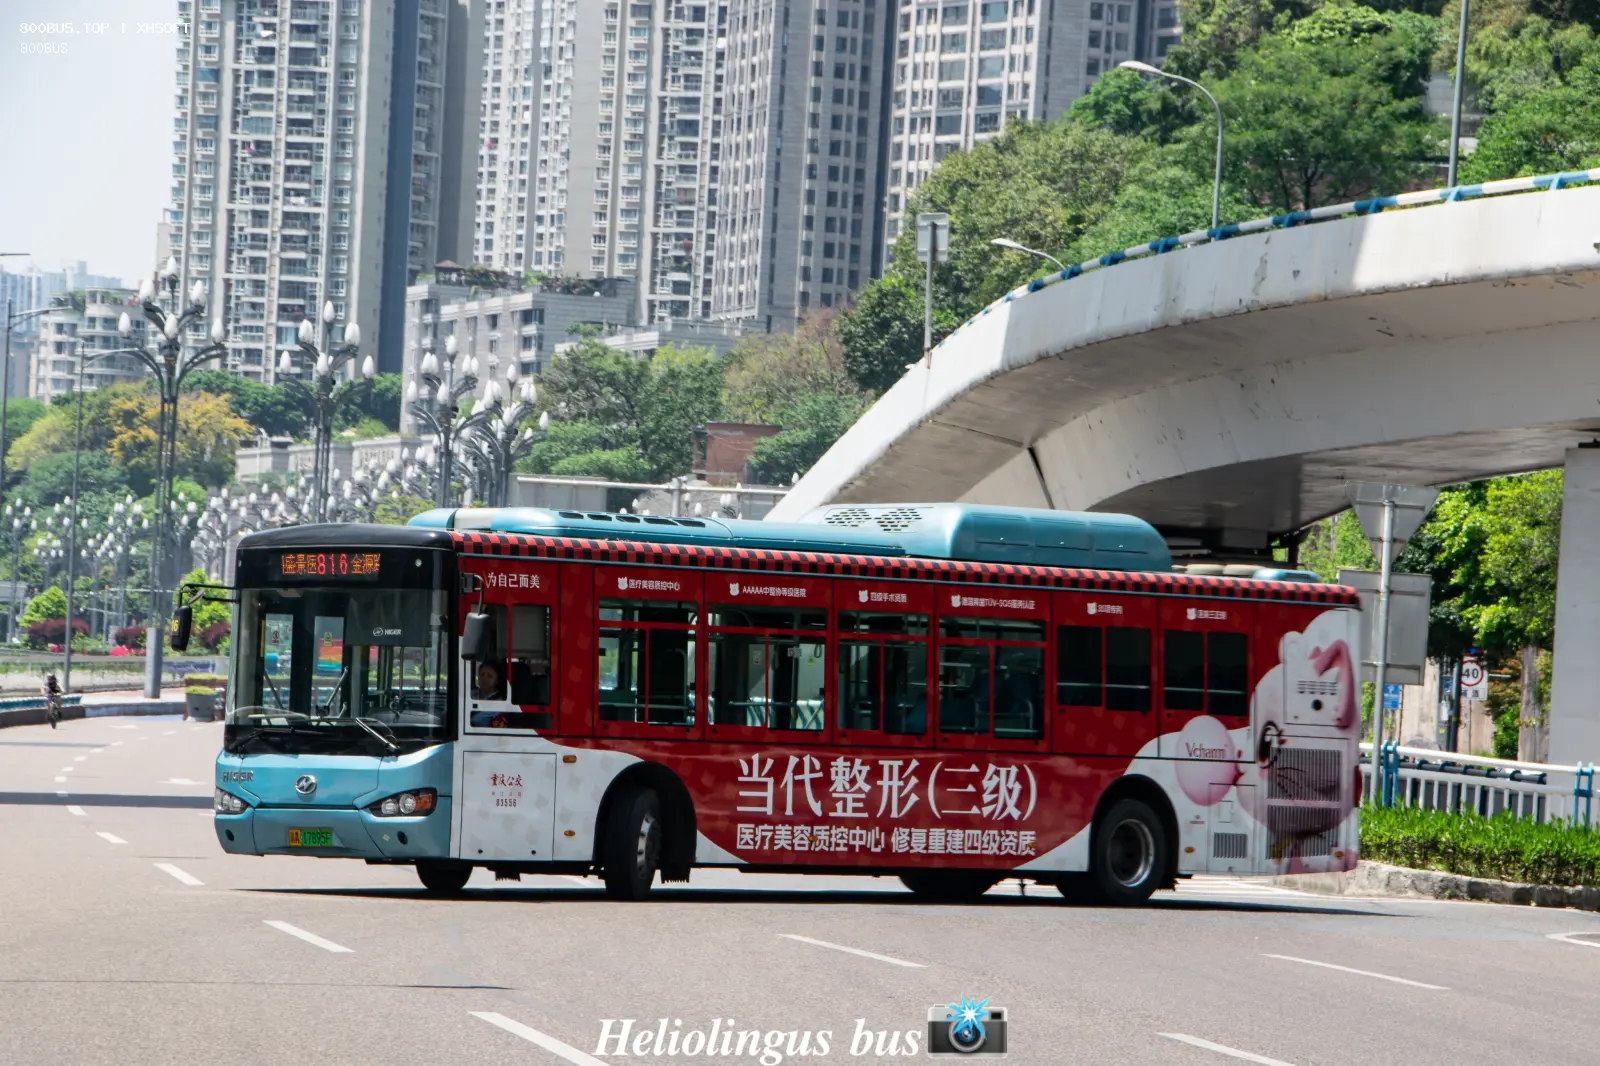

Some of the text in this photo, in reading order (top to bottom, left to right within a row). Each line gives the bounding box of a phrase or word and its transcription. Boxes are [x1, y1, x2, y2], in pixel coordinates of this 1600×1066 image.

[317, 553, 348, 575] 816
[487, 572, 540, 589] 为自己而美
[1462, 668, 1479, 679] 40
[222, 770, 254, 783] HIGER
[490, 773, 523, 787] 重庆公交
[736, 823, 1037, 857] 医疗美容质控中心 修复重建四级资质
